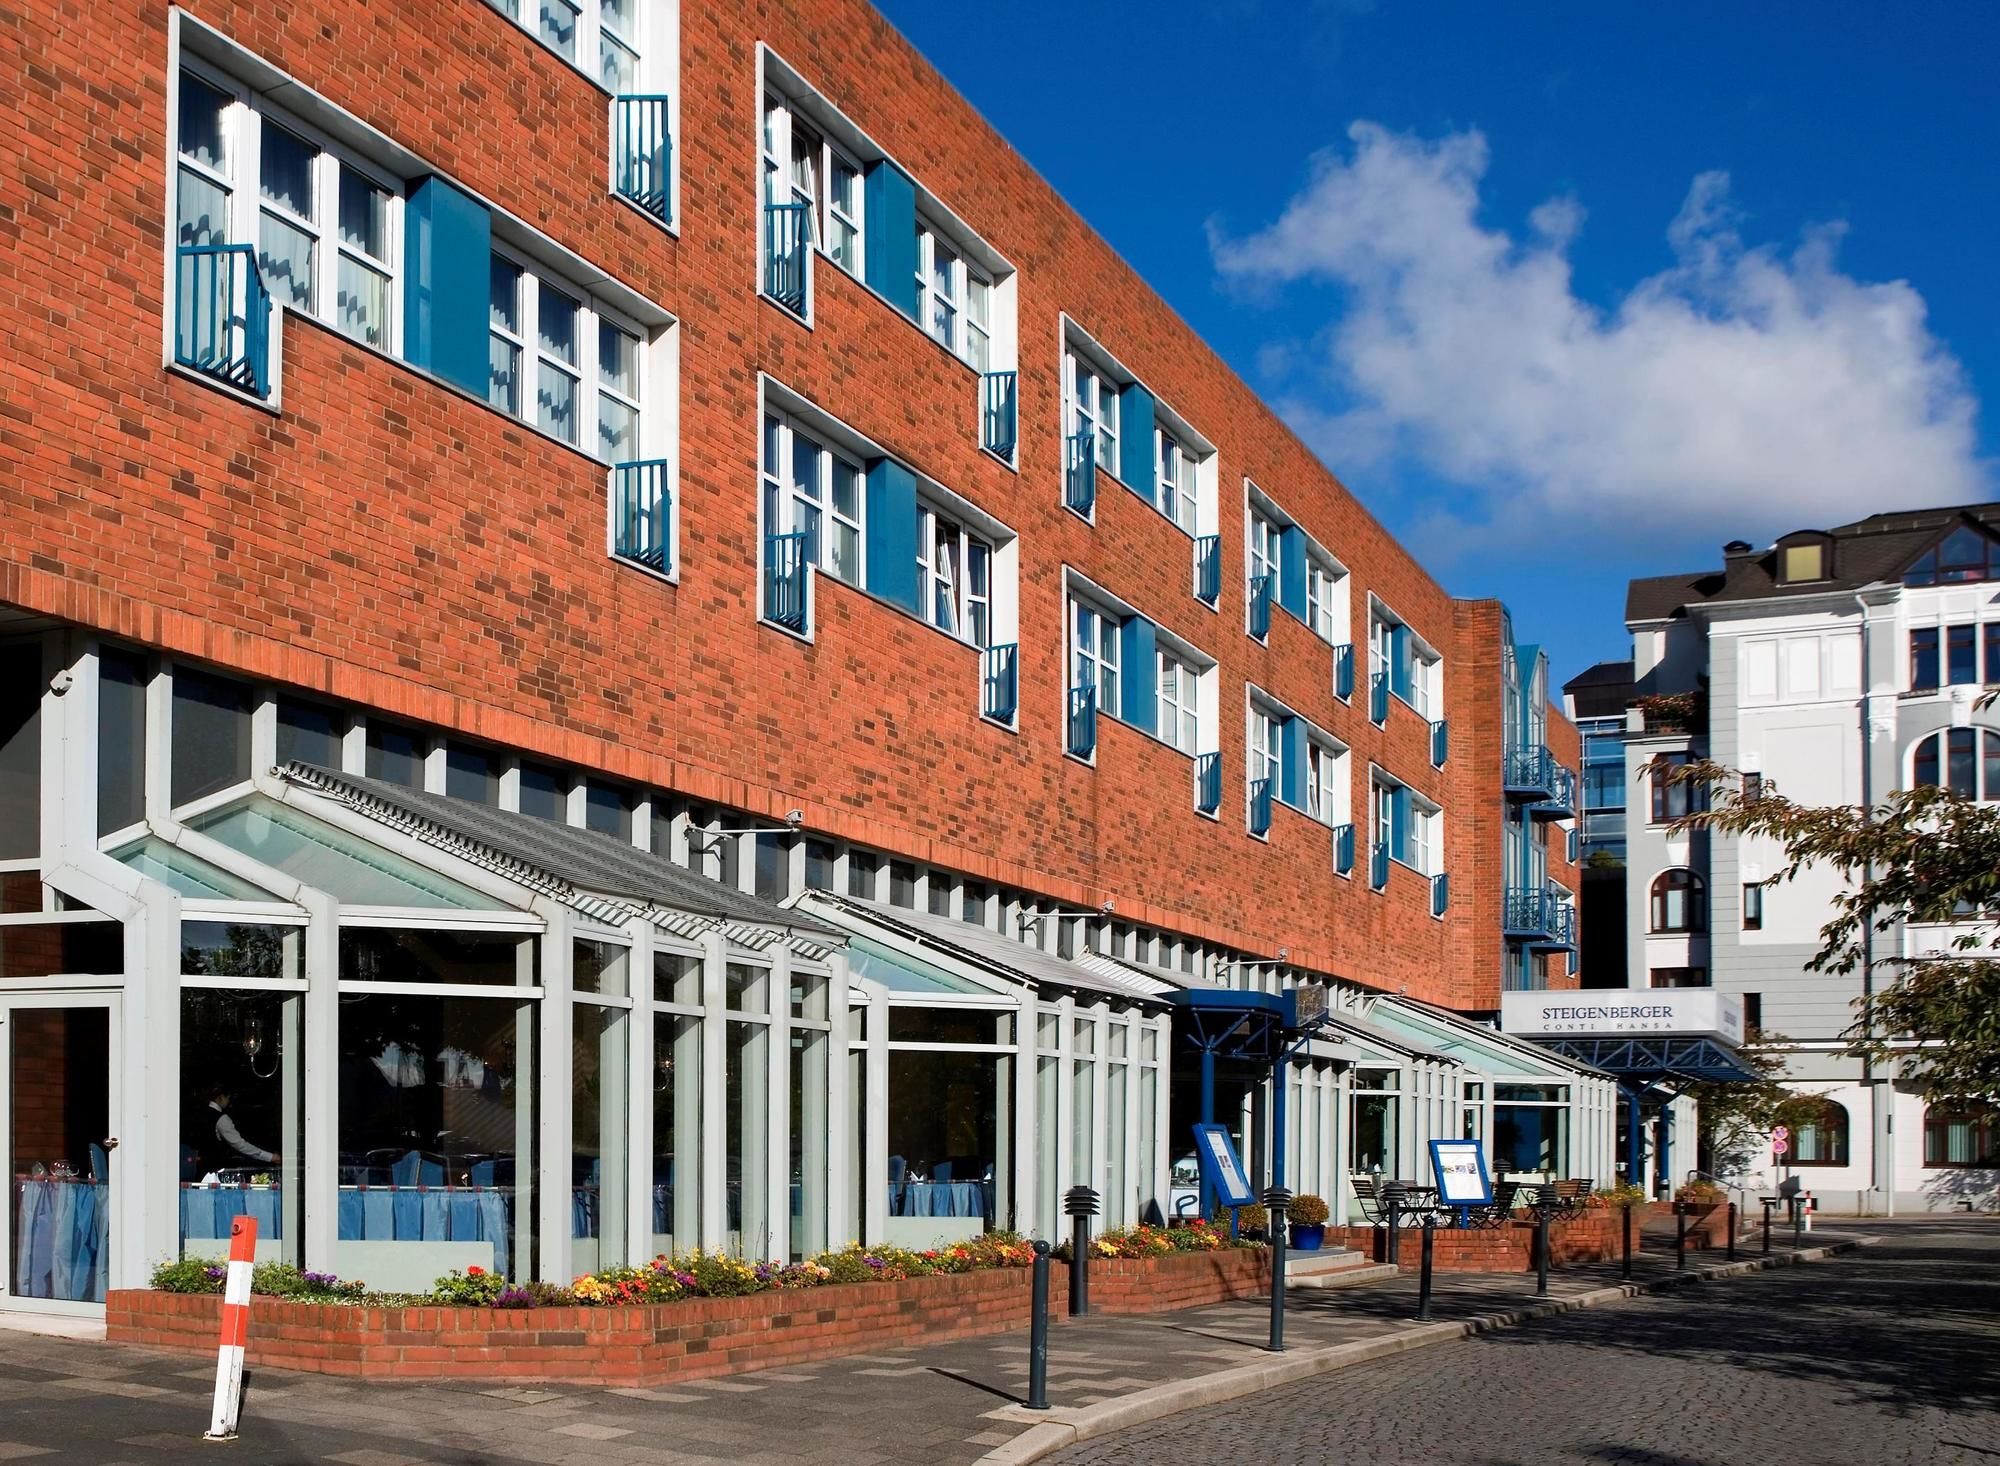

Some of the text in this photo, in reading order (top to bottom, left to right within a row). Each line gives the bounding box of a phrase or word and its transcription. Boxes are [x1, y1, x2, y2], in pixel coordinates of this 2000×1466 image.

[1542, 1006, 1673, 1019] STEIGENBERGER
[1543, 1022, 1672, 1031] CONTI HANSA
